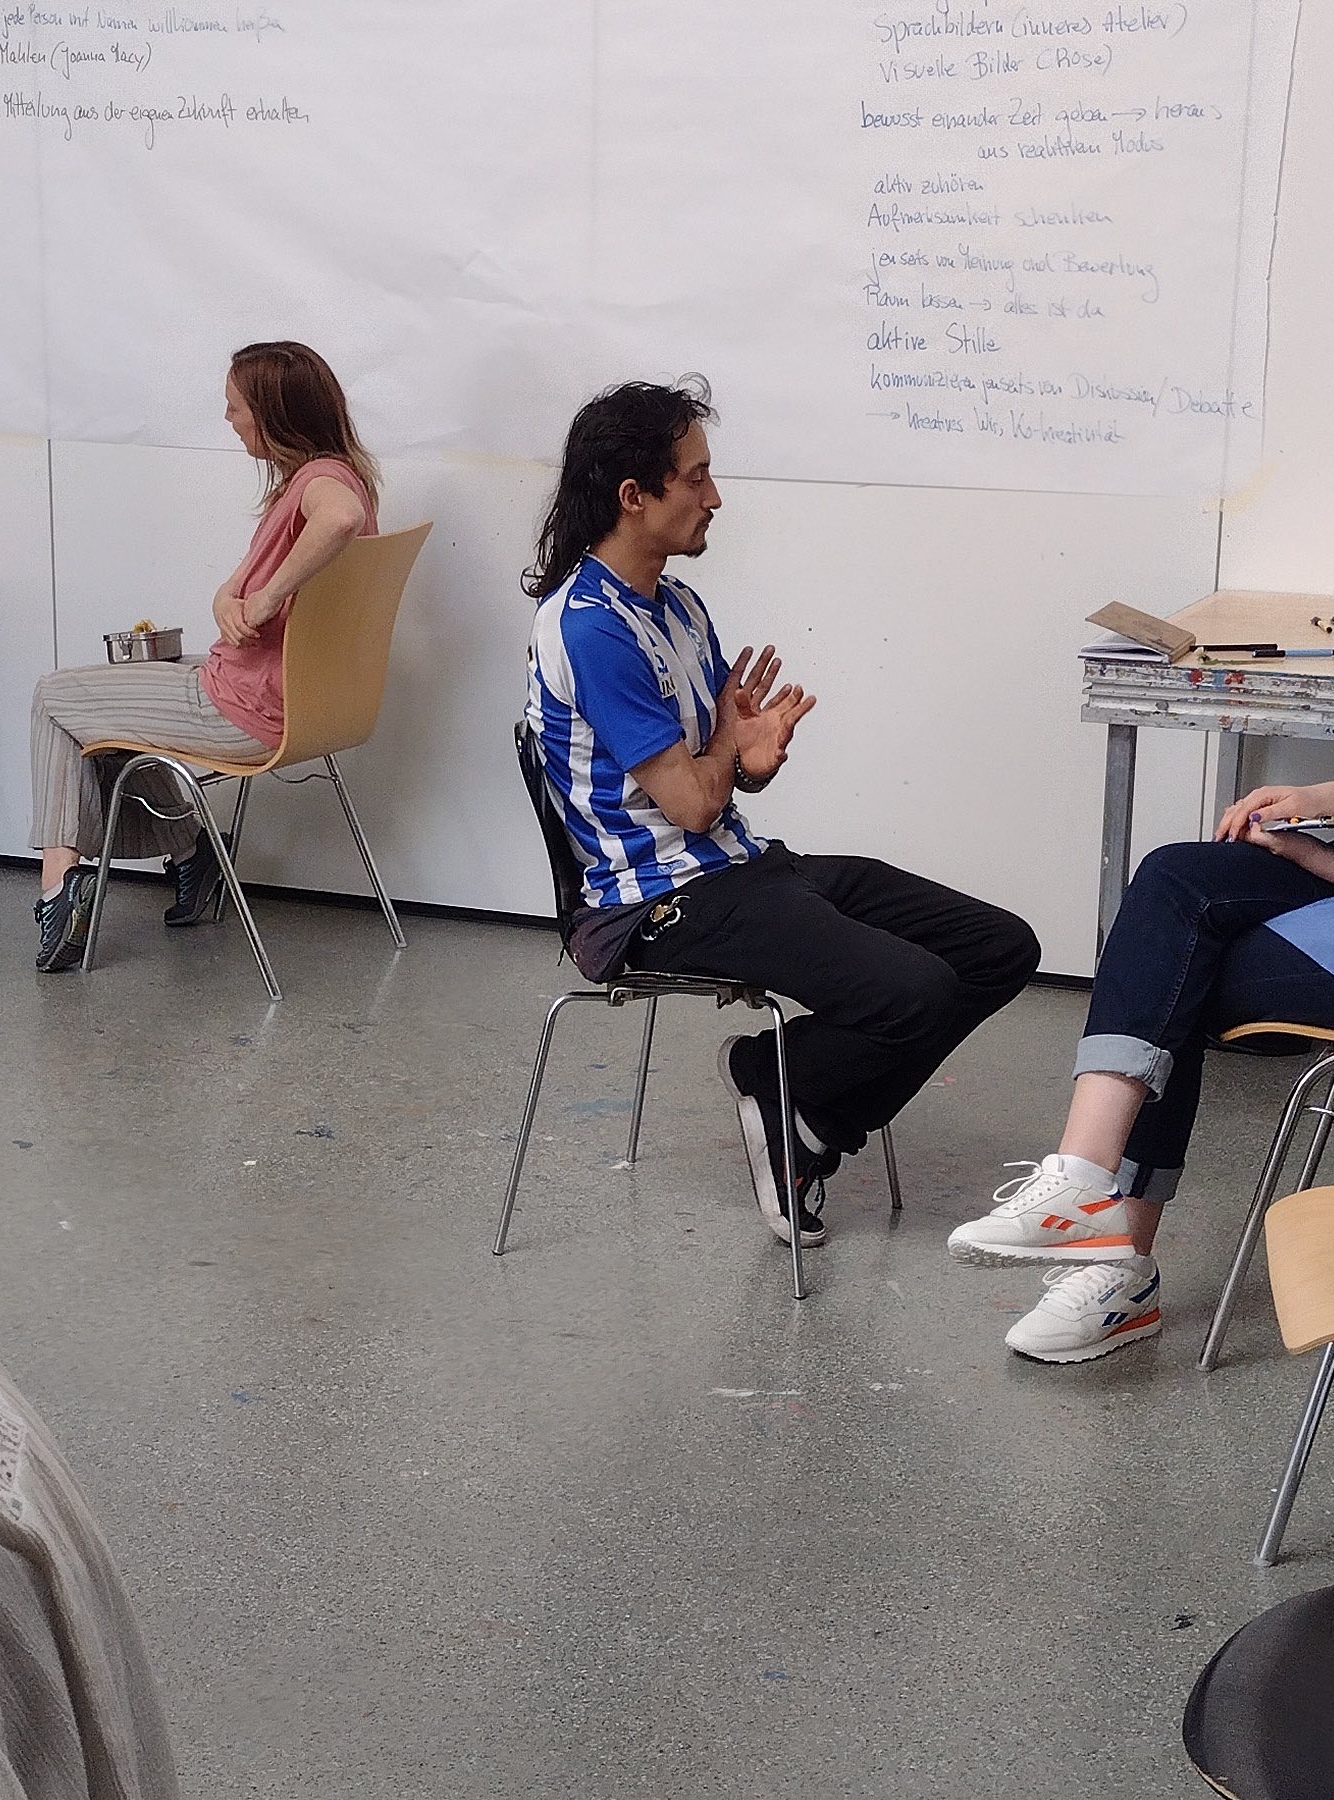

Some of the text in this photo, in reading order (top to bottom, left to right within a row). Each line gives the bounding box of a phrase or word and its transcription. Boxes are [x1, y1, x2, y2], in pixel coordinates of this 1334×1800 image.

[4, 91, 72, 141] Mitteilung
[73, 105, 99, 120] aus
[104, 101, 125, 121] der
[177, 92, 237, 128] Zukunft
[860, 100, 924, 128] bewusst
[931, 107, 999, 130] einander
[1008, 97, 1043, 127] Zeit
[977, 145, 1009, 160] aus
[873, 172, 985, 195] aktiv zuhören
[867, 202, 1001, 232] Aufmerksamkeit
[866, 320, 1003, 354] aktive Stille
